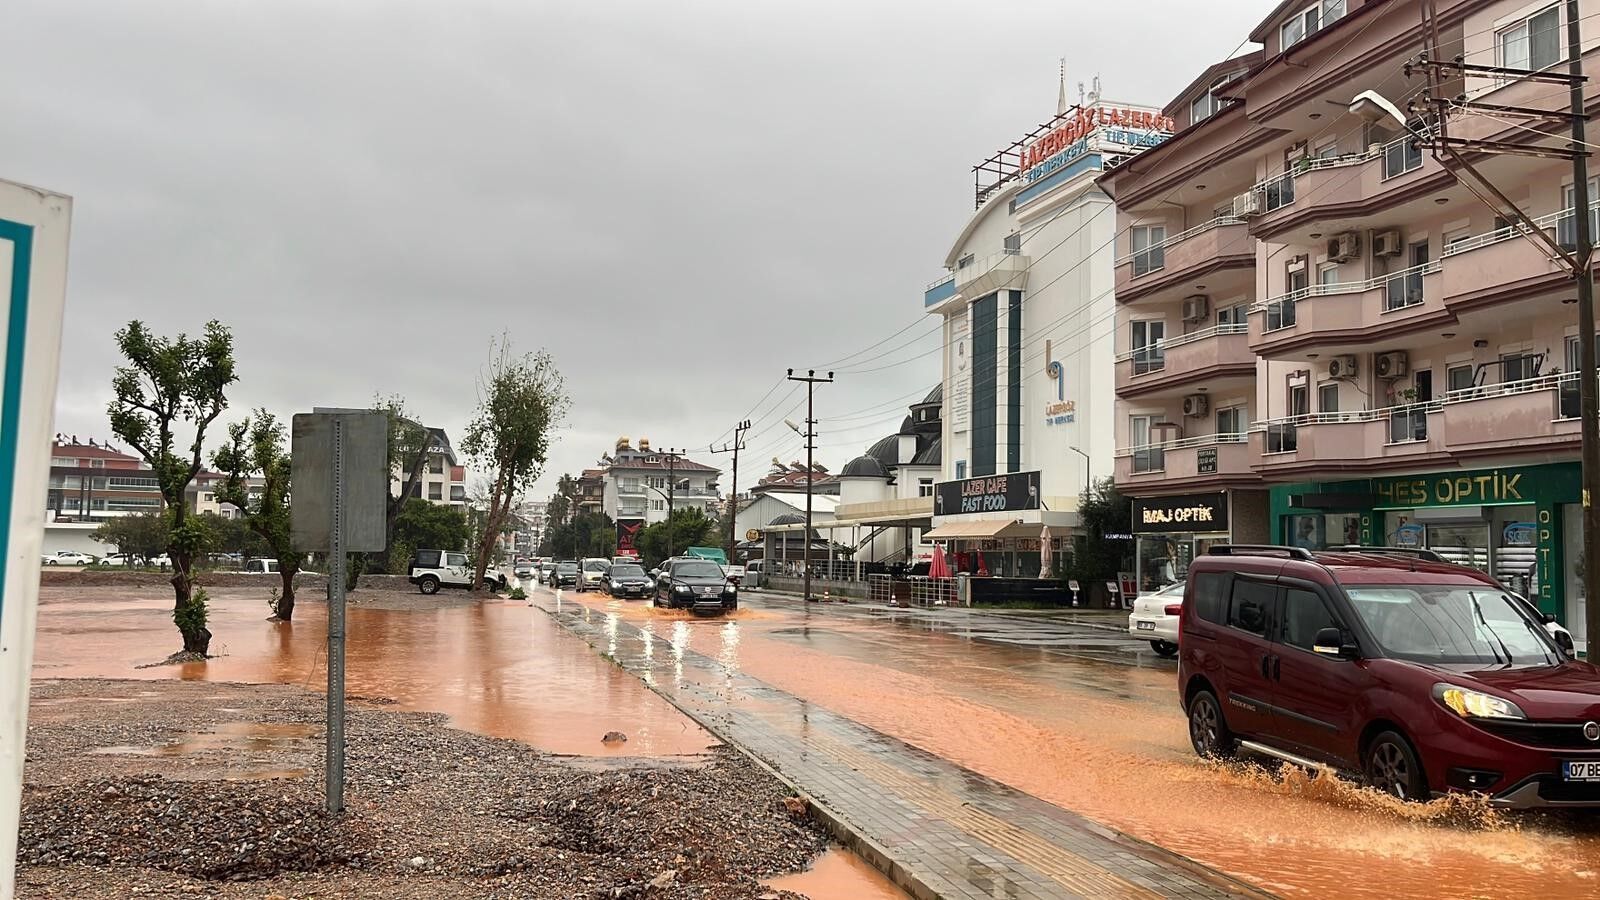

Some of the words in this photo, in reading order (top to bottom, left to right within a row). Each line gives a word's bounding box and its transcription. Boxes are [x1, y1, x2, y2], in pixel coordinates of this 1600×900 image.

[1020, 106, 1097, 173] LAZERGÖZ
[961, 479, 985, 496] LAZER
[987, 476, 1007, 494] CAFE
[1378, 480, 1428, 504] HES
[1435, 470, 1522, 502] OPTİK
[961, 495, 983, 512] FAST
[983, 494, 1006, 511] FOOD
[1142, 506, 1173, 524] İMAJ
[1174, 504, 1213, 522] OPTİK
[1570, 763, 1585, 777] 07
